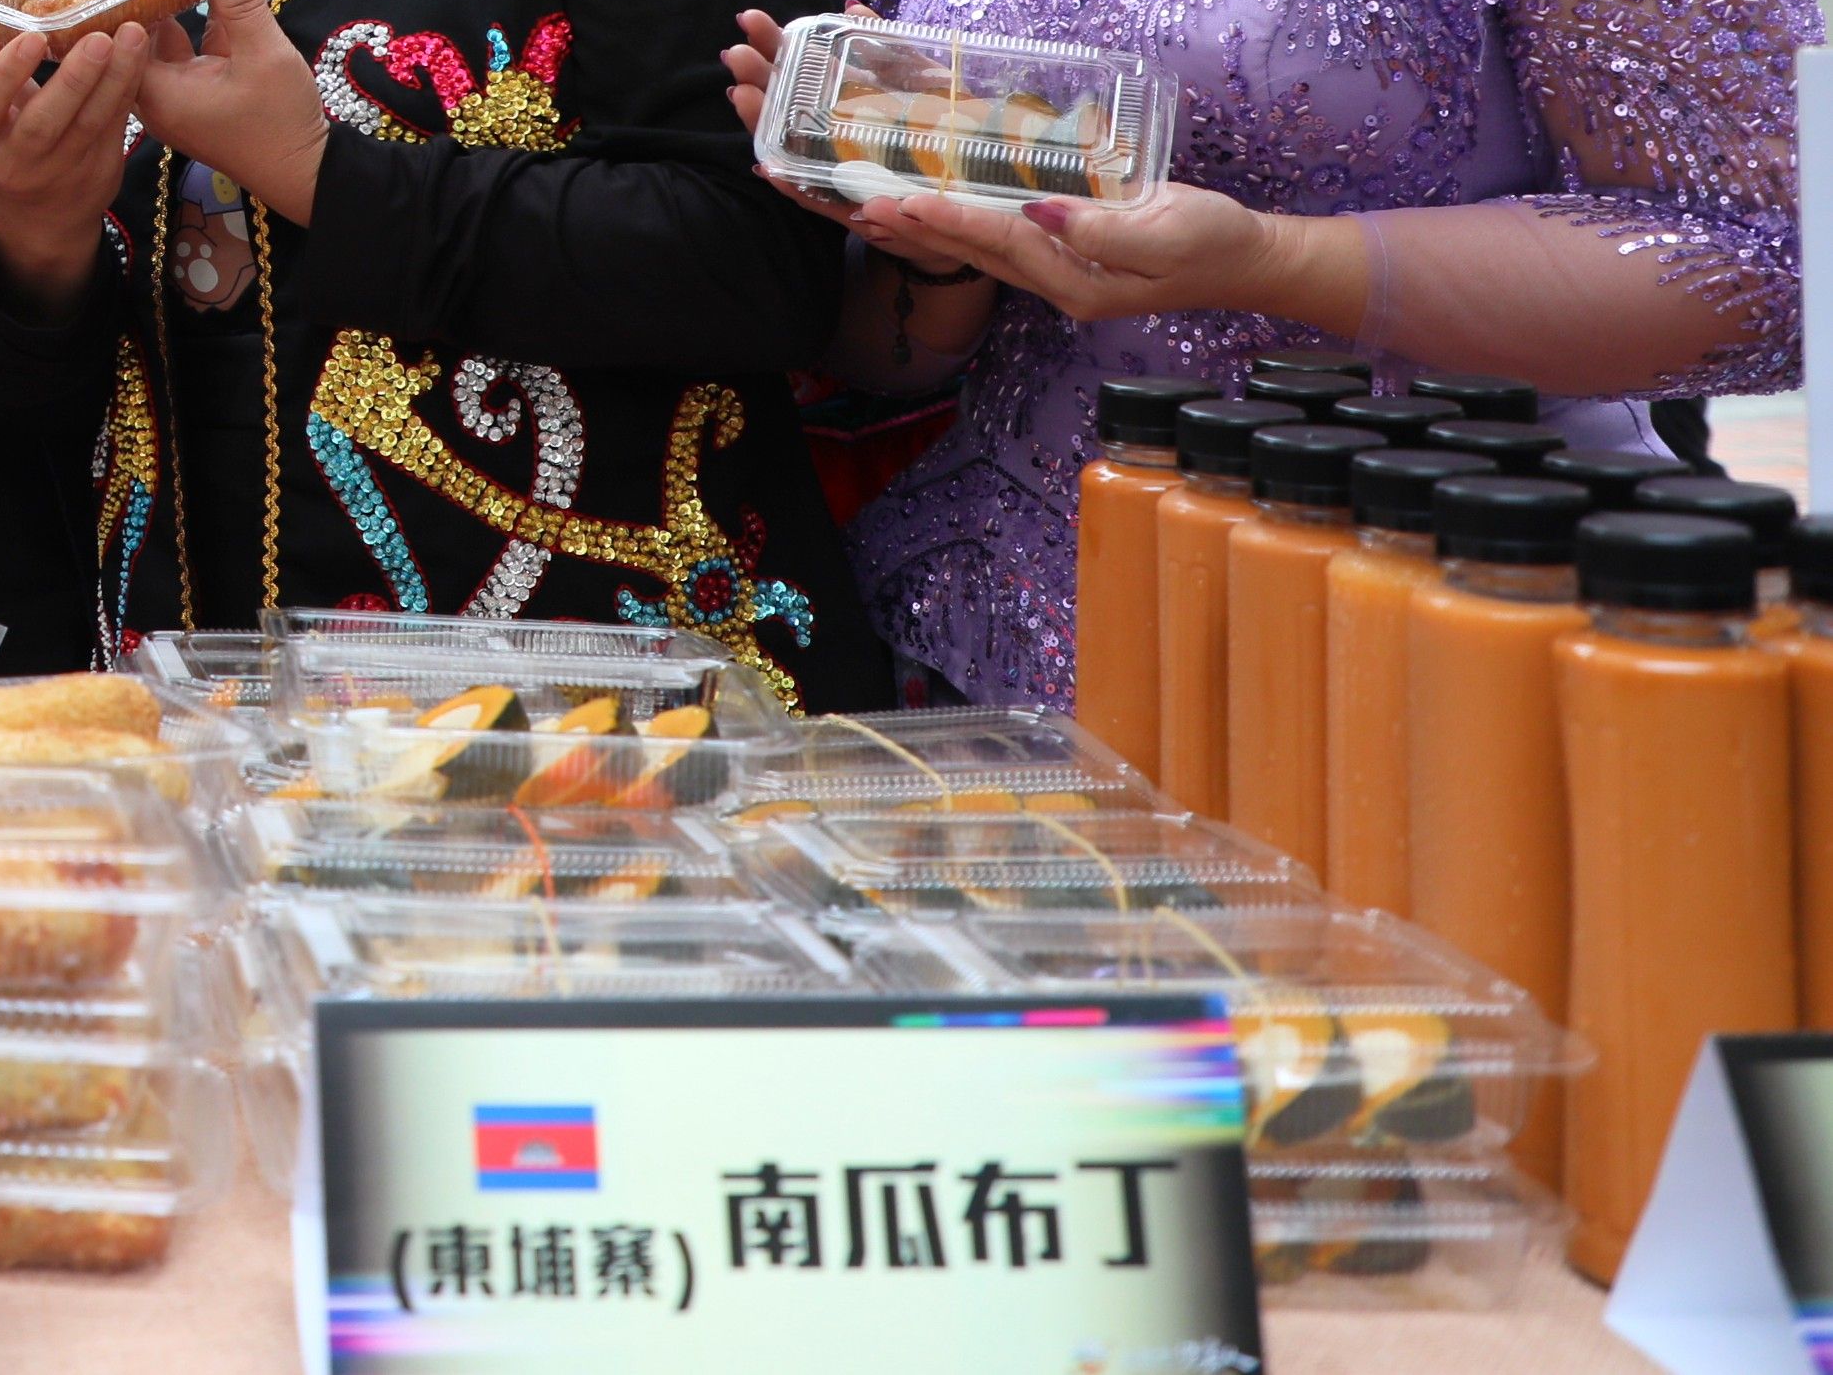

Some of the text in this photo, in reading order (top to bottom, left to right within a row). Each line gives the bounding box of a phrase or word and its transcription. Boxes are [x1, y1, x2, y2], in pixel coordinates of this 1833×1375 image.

[391, 1161, 1179, 1313] (柬埔寨) 南瓜布丁
